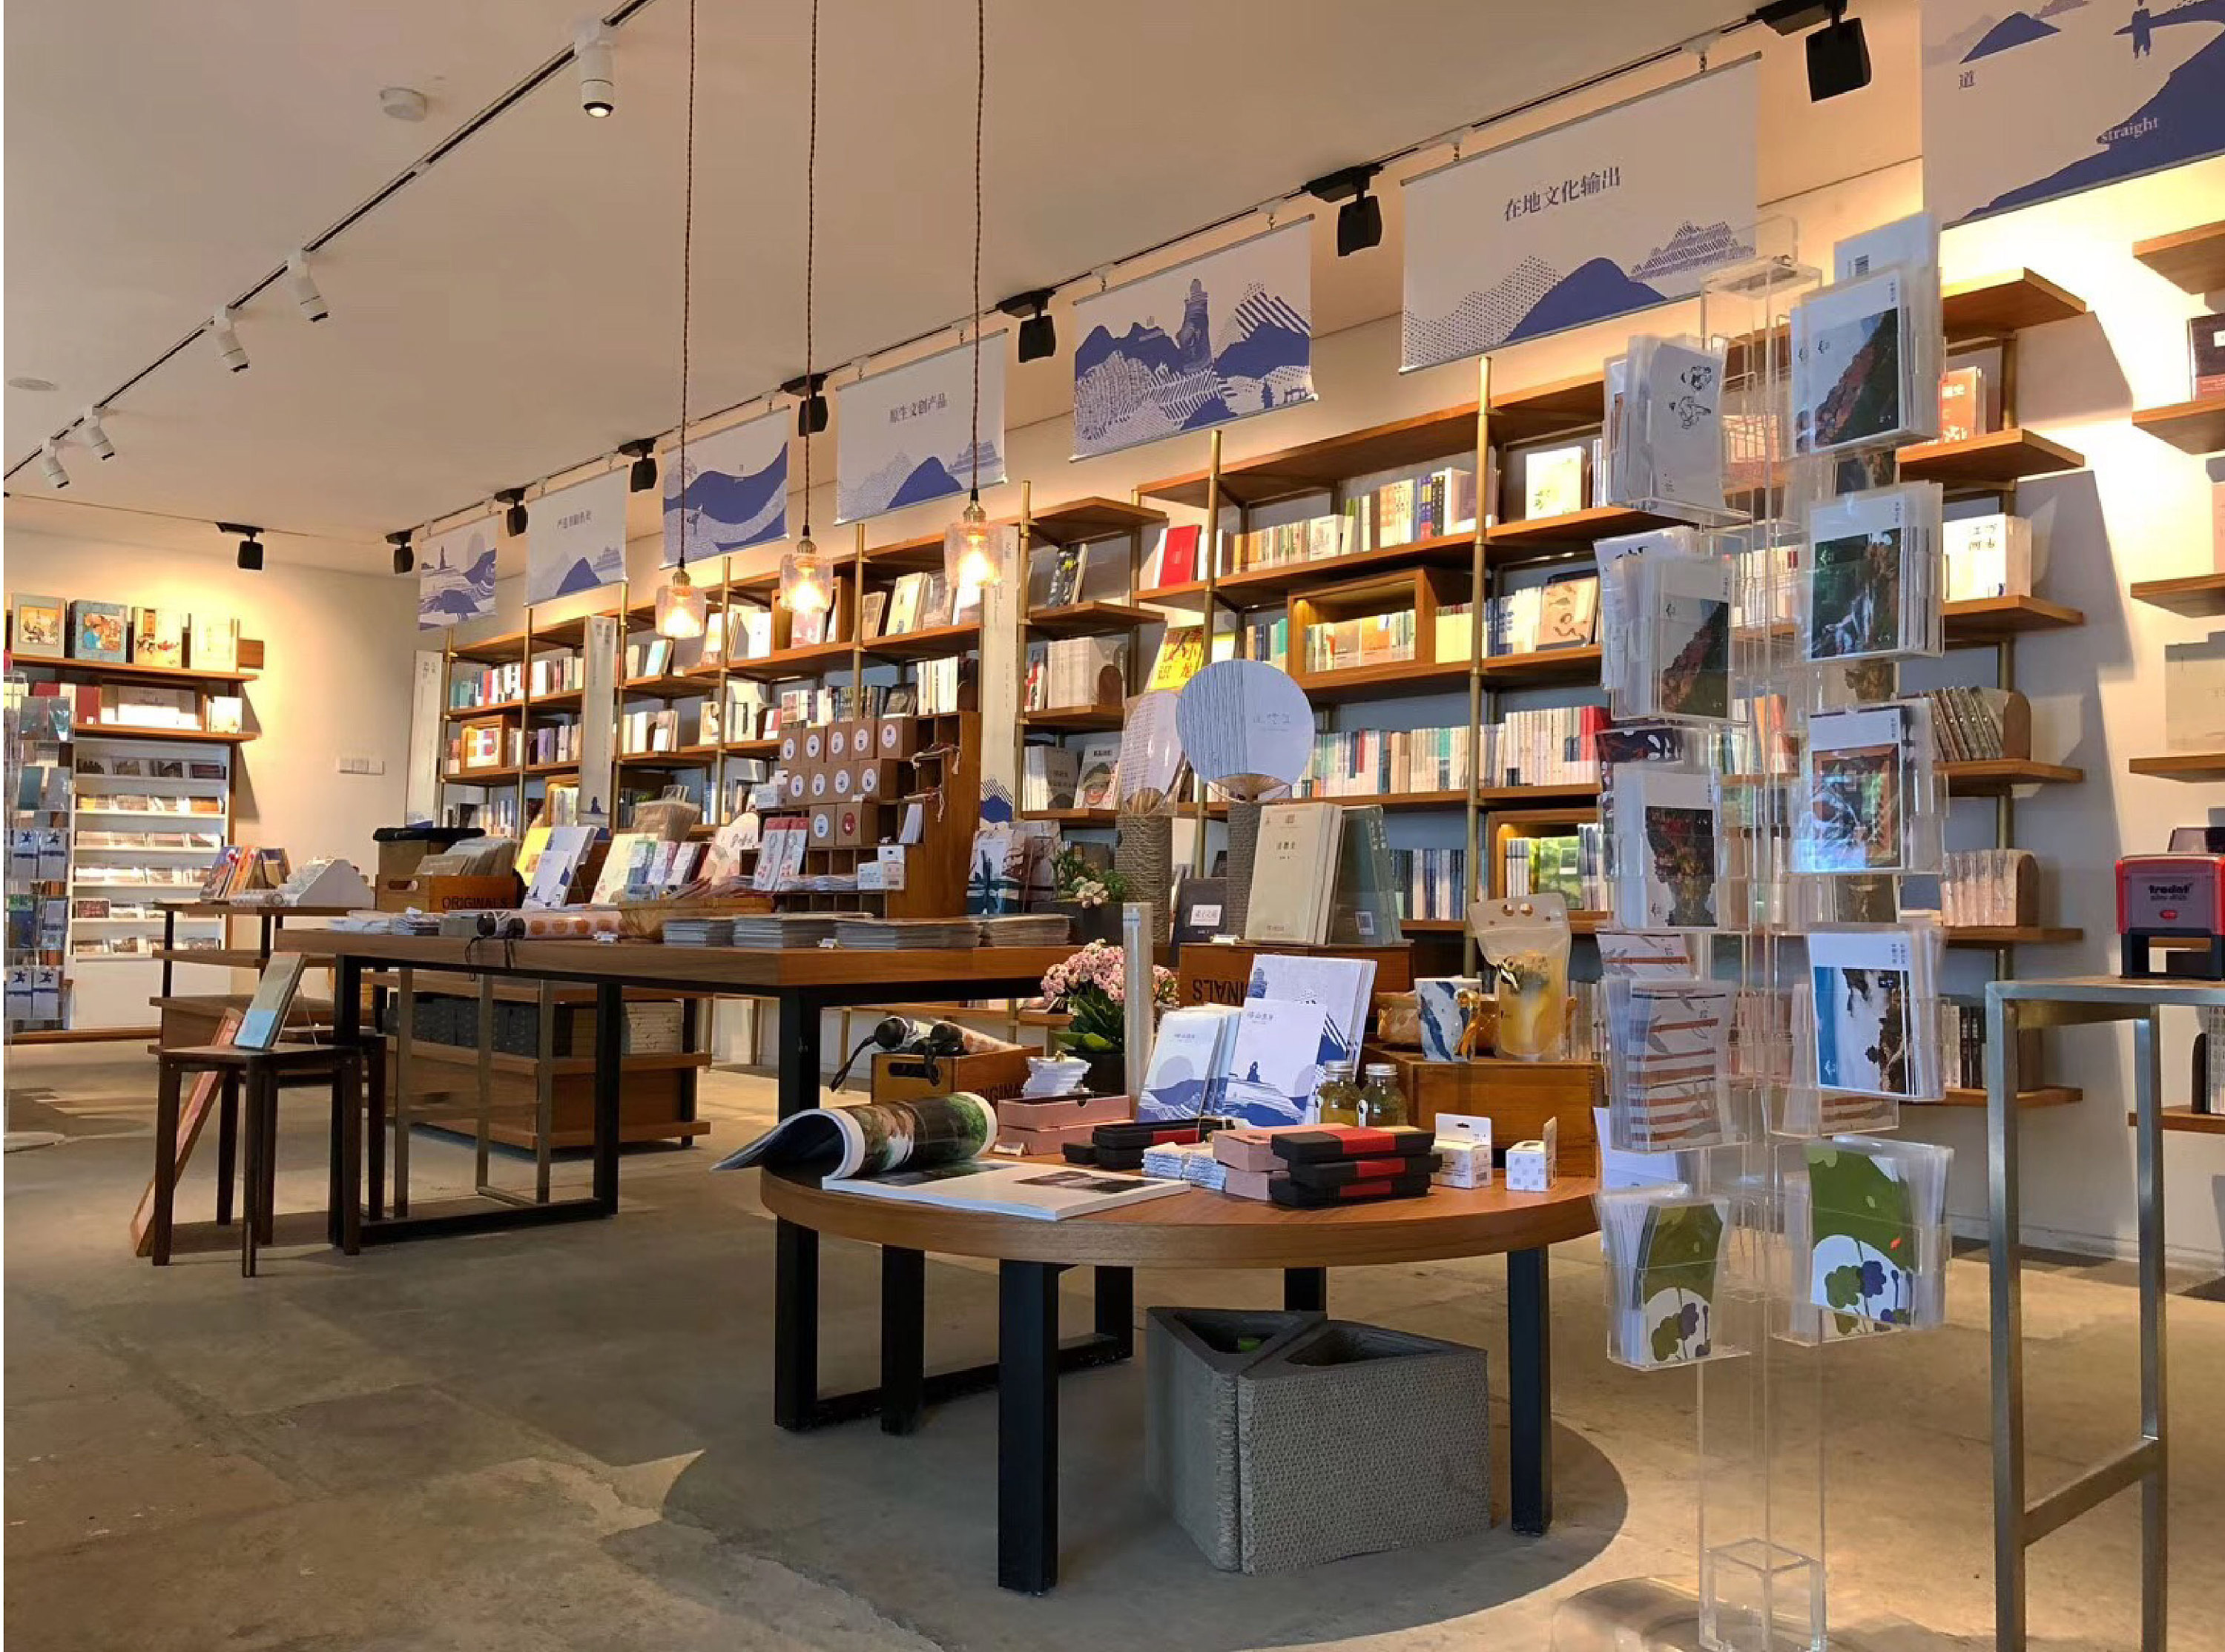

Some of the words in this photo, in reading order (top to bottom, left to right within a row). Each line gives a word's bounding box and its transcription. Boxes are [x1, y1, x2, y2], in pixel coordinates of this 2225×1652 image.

[1959, 70, 1976, 89] 道
[2099, 117, 2158, 143] straight
[1504, 166, 1621, 222] 在地文化输出
[890, 391, 946, 423] 原生文创产品
[1192, 978, 1247, 1005] INALS
